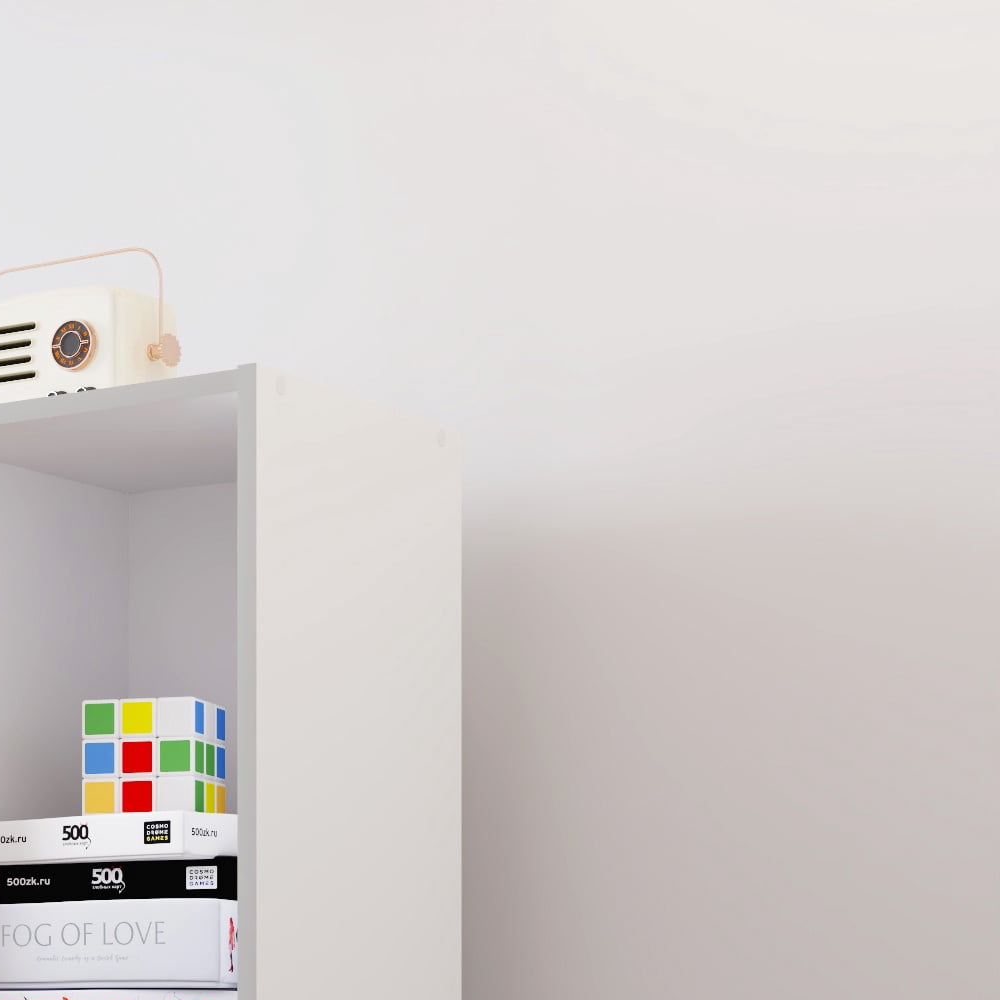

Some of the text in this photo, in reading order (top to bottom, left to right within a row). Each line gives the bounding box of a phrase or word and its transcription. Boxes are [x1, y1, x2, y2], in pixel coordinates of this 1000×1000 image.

[62, 824, 89, 840] 500
[191, 828, 218, 838] 500zk.ru
[6, 876, 51, 887] 500zk.ru
[91, 867, 123, 884] 500
[1, 921, 166, 947] FOG OF LOVE
